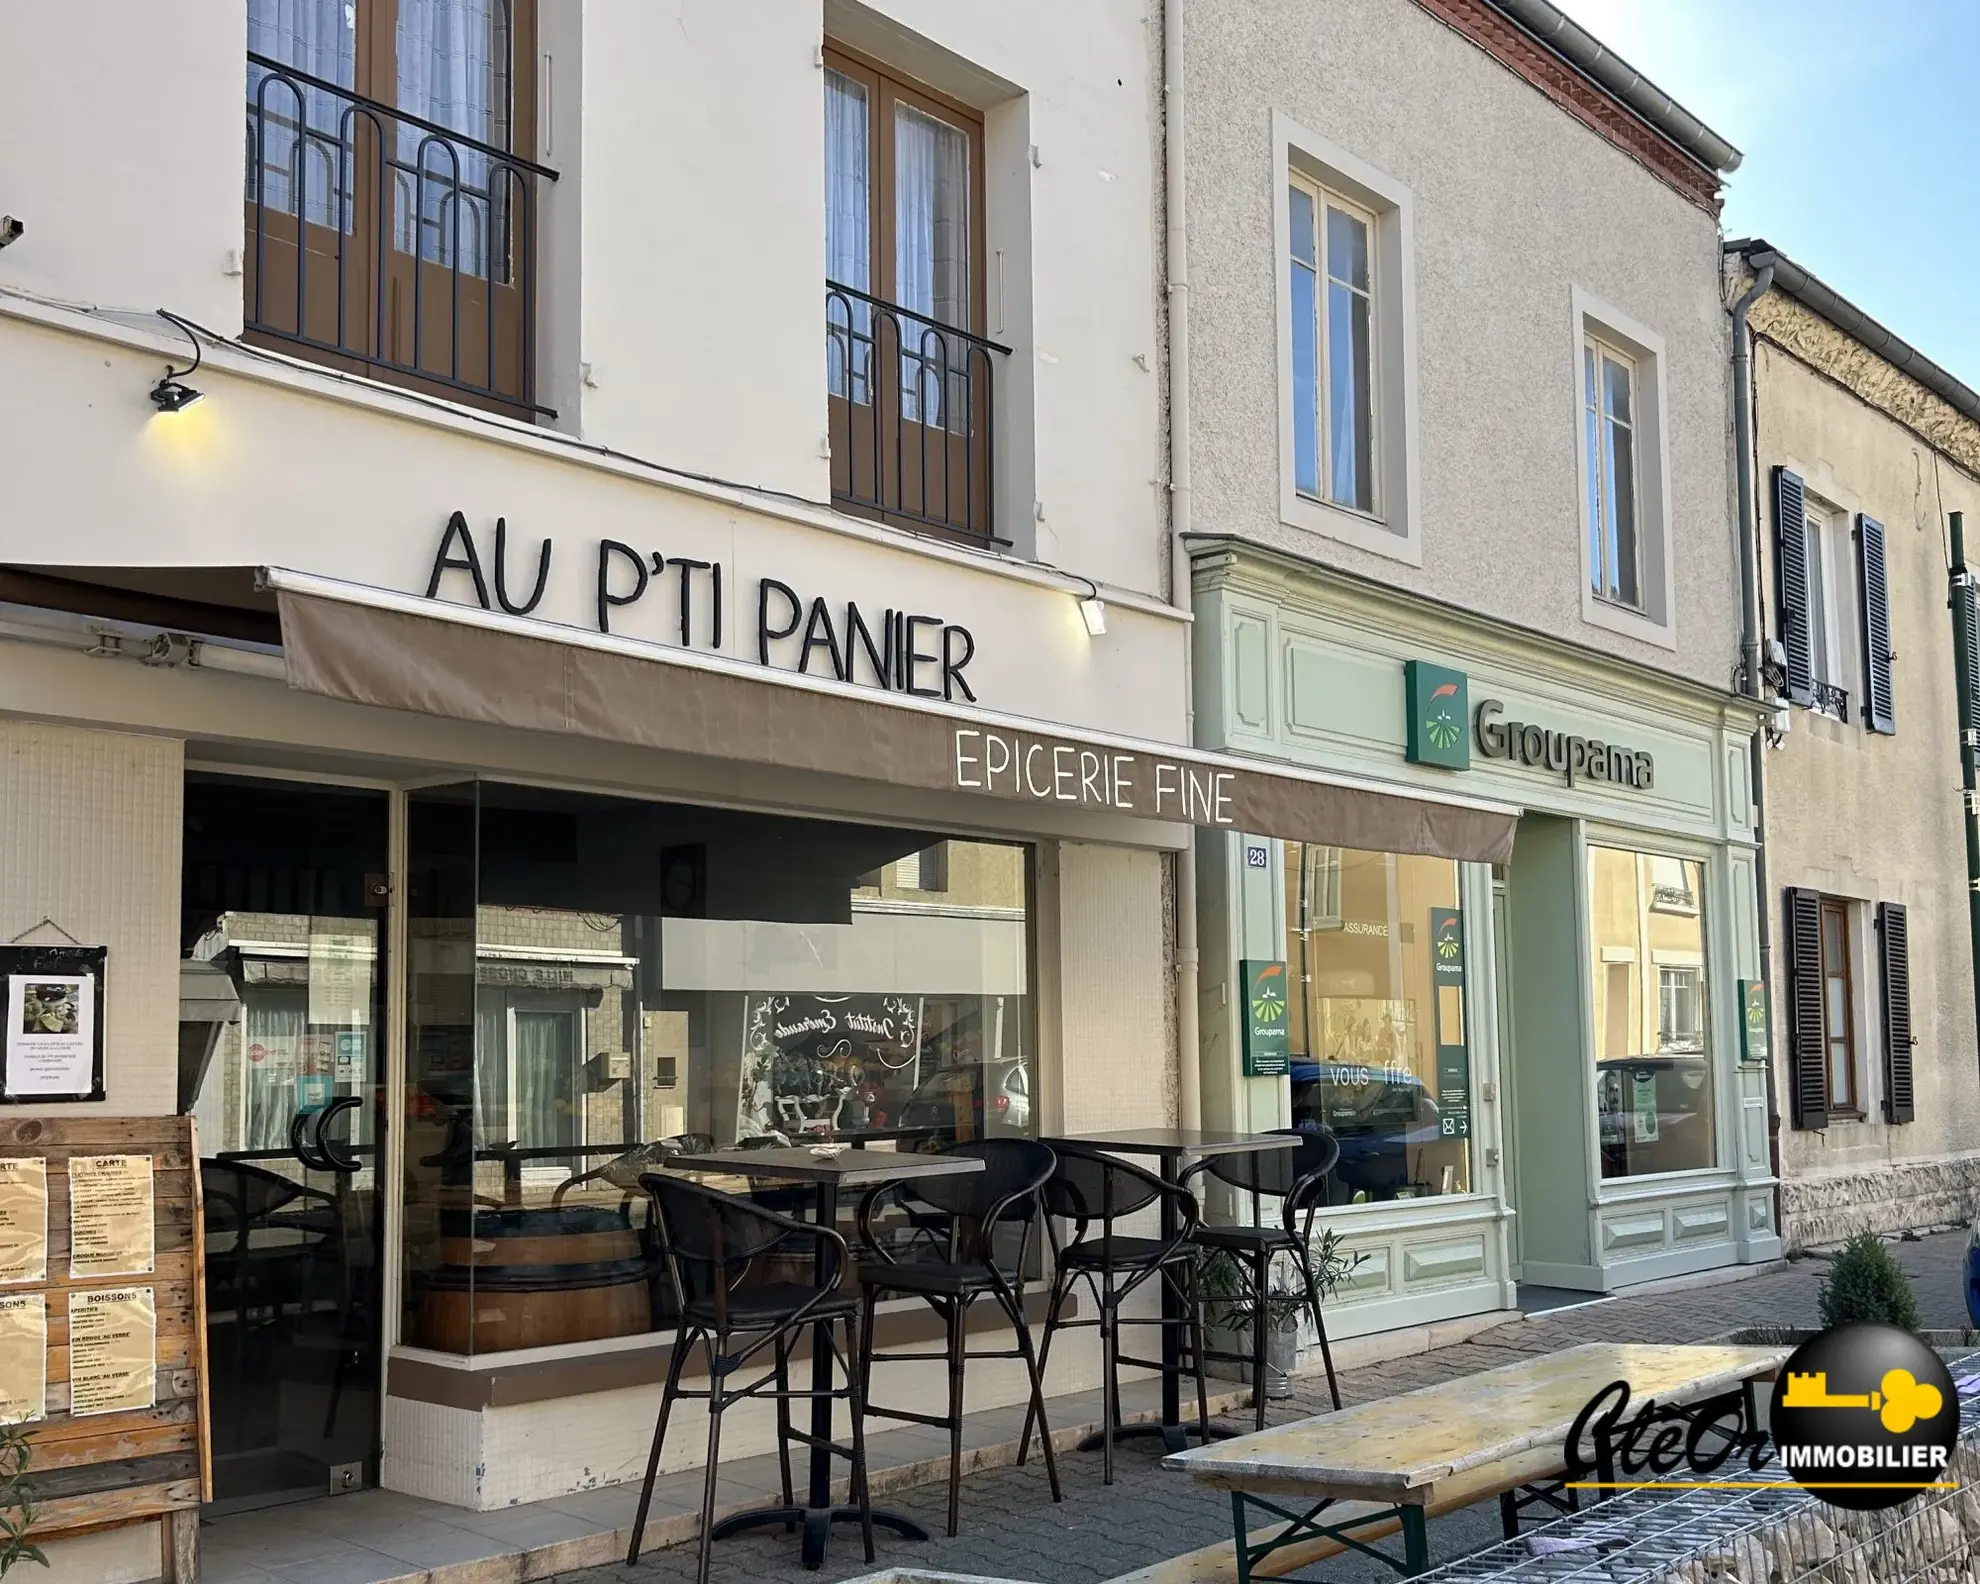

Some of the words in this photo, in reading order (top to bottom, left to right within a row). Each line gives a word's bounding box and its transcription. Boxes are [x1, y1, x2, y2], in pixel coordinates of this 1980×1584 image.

[426, 511, 552, 616] AU
[599, 559, 721, 649] P'TI
[758, 577, 977, 703] PANIER
[1475, 699, 1654, 789] Groupama
[955, 730, 1135, 808] EPICERIE
[1155, 764, 1236, 824] FINE
[1250, 849, 1265, 866] 28
[1343, 922, 1388, 937] ASSURANCE
[1436, 962, 1462, 973] Groupama
[1254, 1026, 1285, 1038] Groupama
[96, 1159, 127, 1168] CARTE
[87, 1292, 137, 1303] BOISSONS
